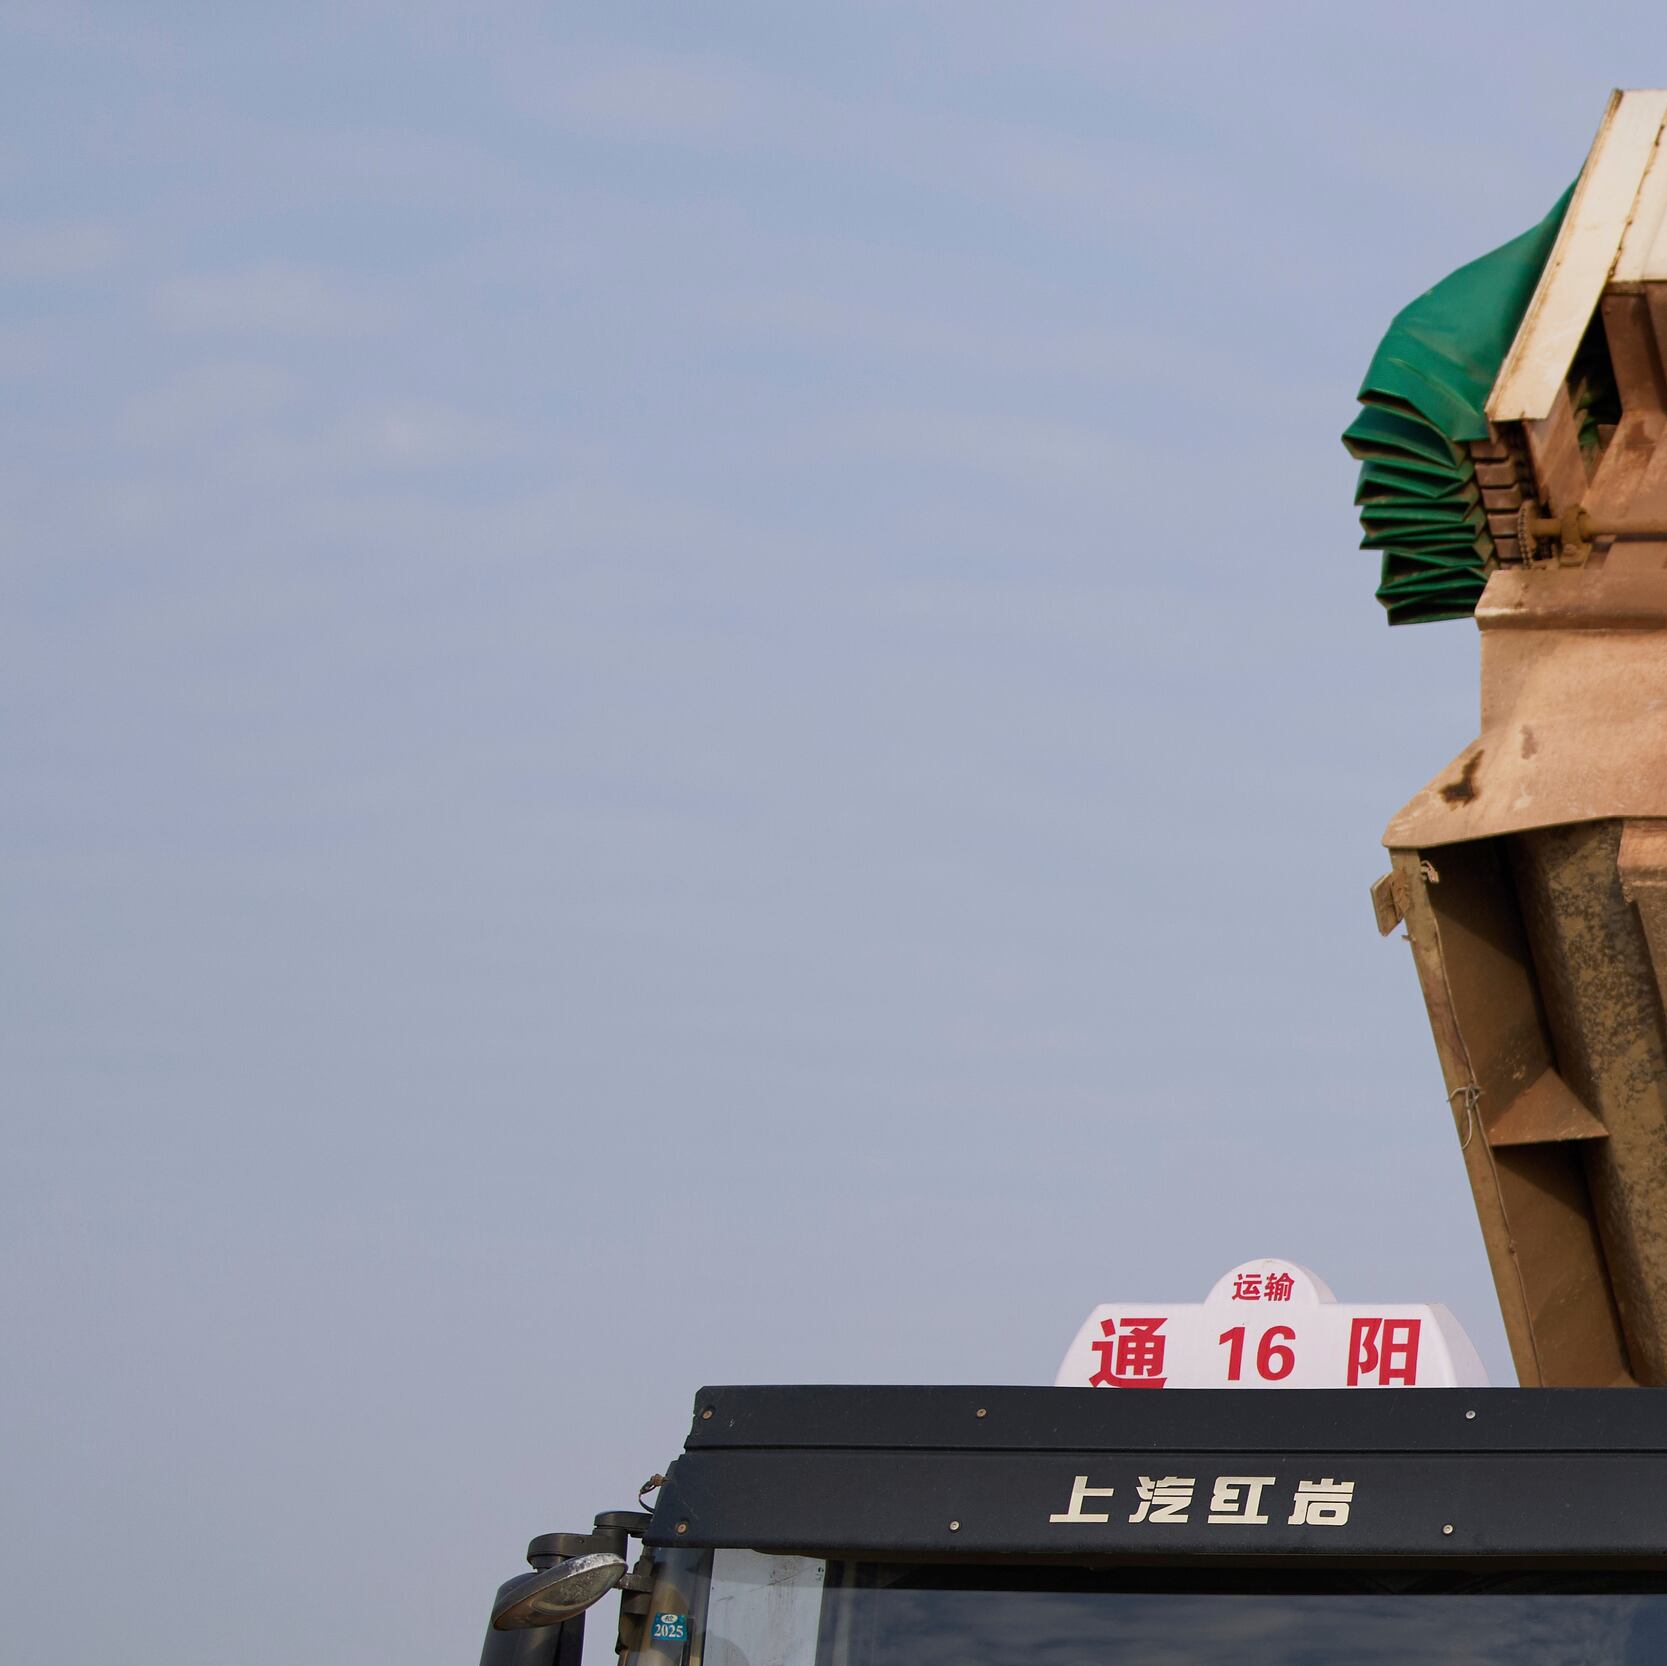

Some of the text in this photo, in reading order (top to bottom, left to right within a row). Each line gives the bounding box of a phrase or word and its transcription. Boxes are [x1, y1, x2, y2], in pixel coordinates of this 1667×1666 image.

[1232, 1272, 1295, 1303] 运输
[1090, 1318, 1421, 1389] 通 16 阳
[1049, 1474, 1356, 1527] 上汽红岩
[654, 1623, 684, 1637] 2025
